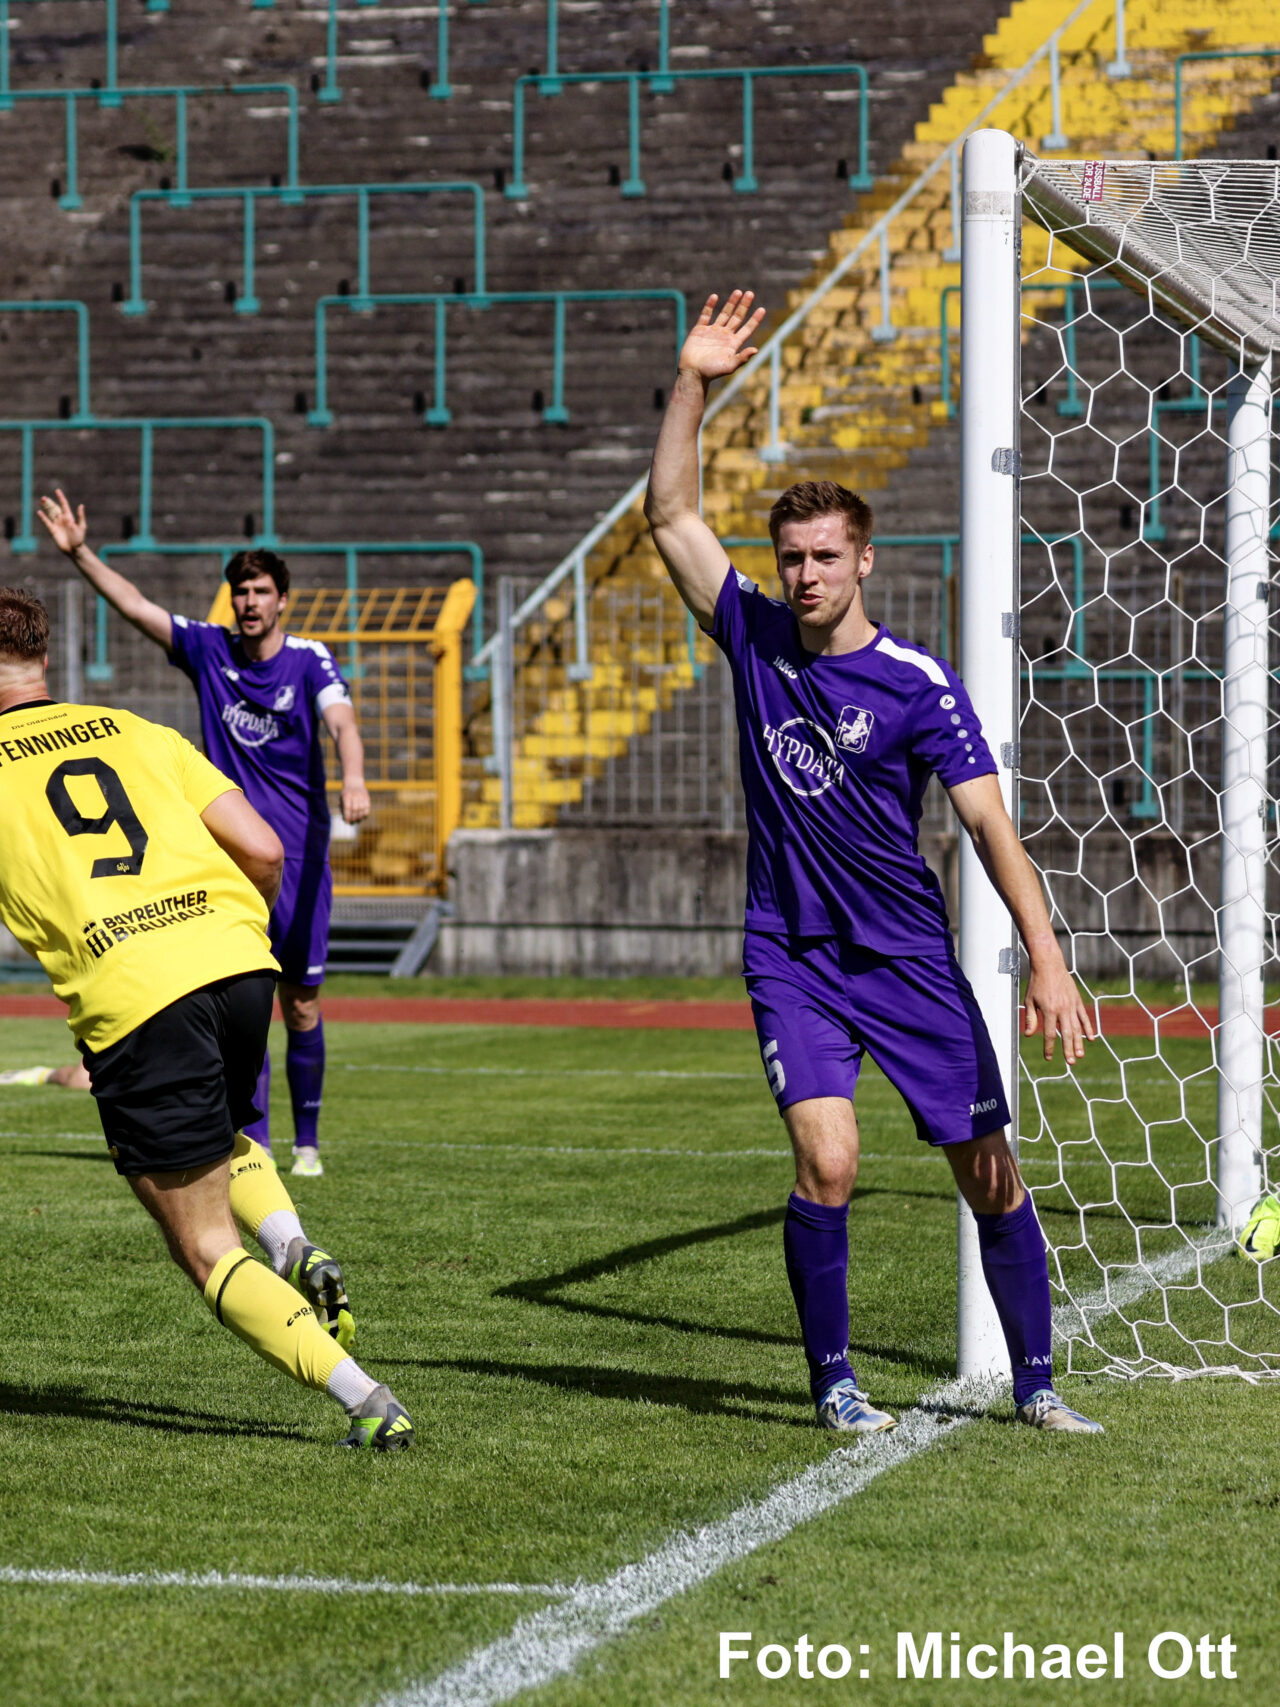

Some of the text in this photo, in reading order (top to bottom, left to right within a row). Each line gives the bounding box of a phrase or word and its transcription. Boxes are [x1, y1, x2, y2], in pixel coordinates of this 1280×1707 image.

[1092, 161, 1104, 200] FUSSBALL
[772, 656, 798, 679] JAKO
[221, 703, 280, 738] HYPDATA
[762, 724, 846, 788] HYPDATA
[45, 757, 149, 878] 9
[102, 889, 208, 929] BAYREUTHER
[111, 905, 216, 943] BRAUHAUS
[762, 1039, 786, 1098] 5
[969, 1098, 998, 1116] JAKO
